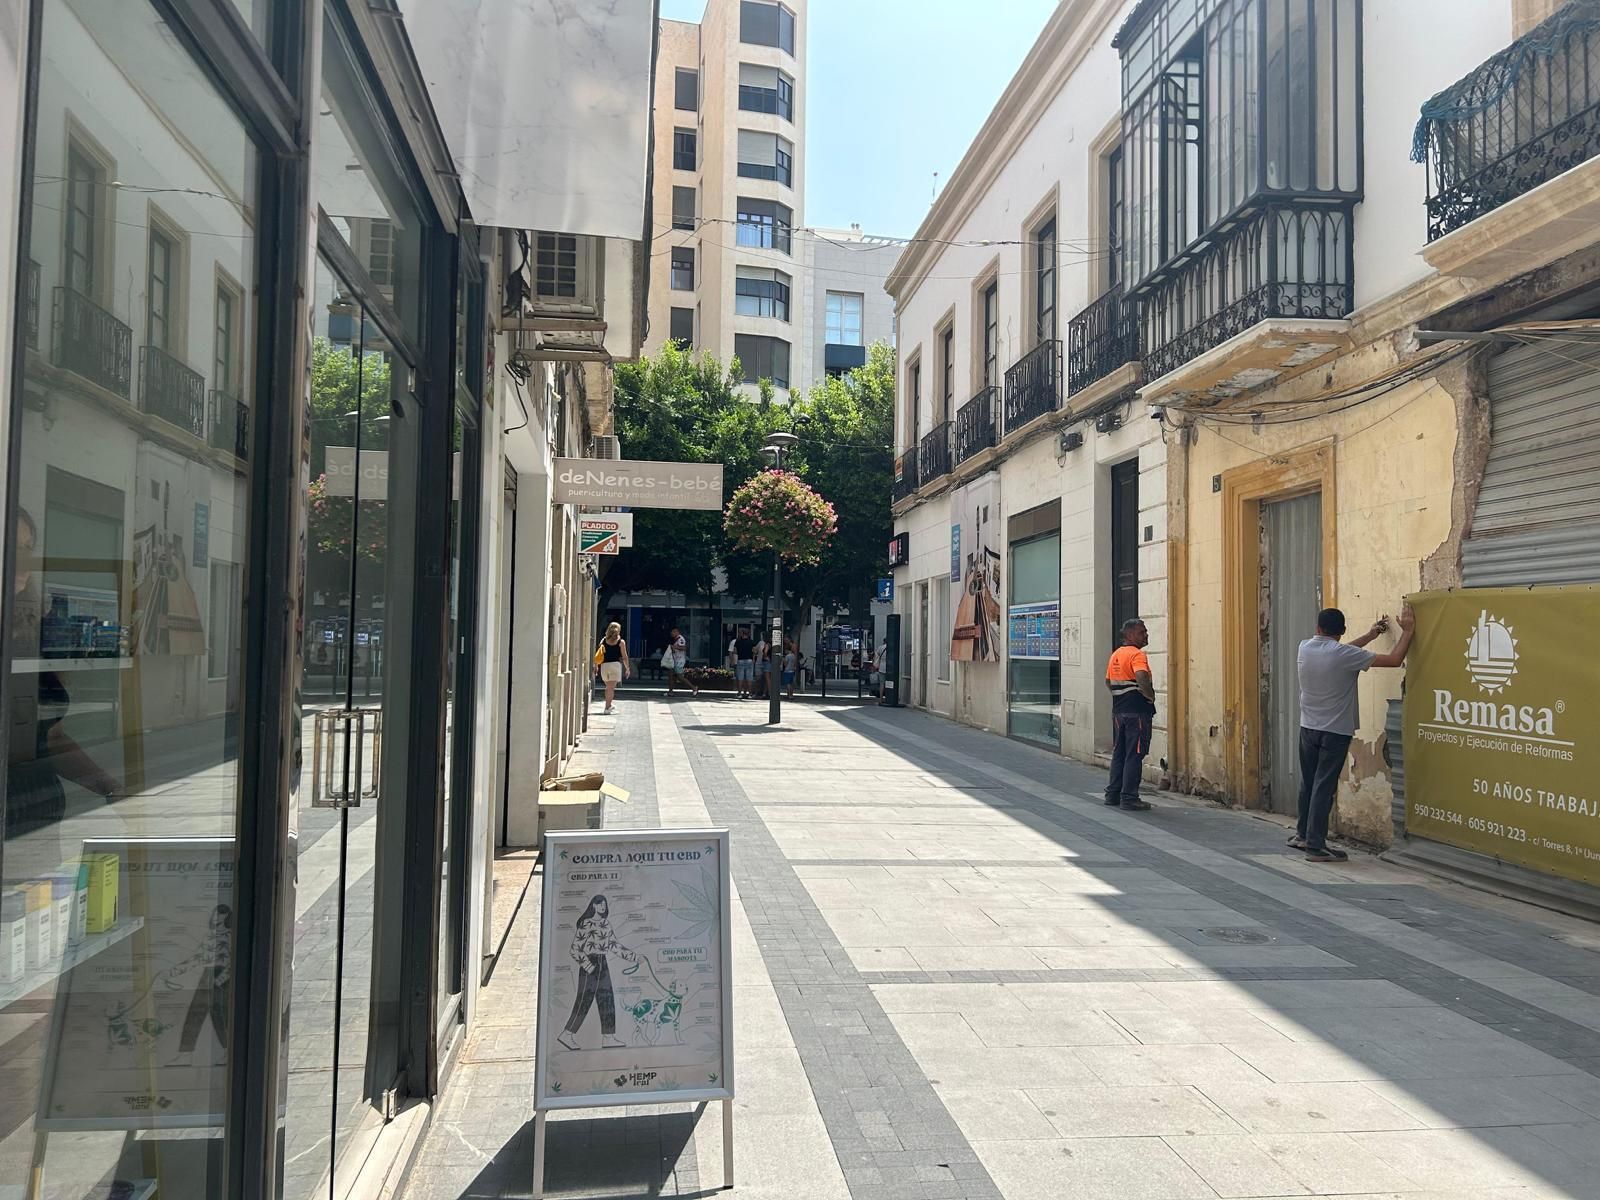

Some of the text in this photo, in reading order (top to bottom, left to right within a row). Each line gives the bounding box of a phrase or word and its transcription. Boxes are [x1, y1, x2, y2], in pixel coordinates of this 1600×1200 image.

[1418, 728, 1574, 761] Proyectos y Ejecución de Reformas
[1473, 778, 1600, 818] 50 AÑOS TRABAJ
[1414, 803, 1429, 817] 950
[1430, 807, 1445, 821] 232
[1446, 811, 1462, 825] 544
[1468, 817, 1486, 832] 605
[1487, 821, 1504, 837] 921
[1507, 826, 1526, 842] 223
[1541, 838, 1565, 853] Torres
[572, 851, 701, 864] COMPRA AQUI TU CBD
[571, 873, 588, 881] CBD
[588, 872, 608, 881] PARA
[629, 1072, 657, 1081] HEMP
